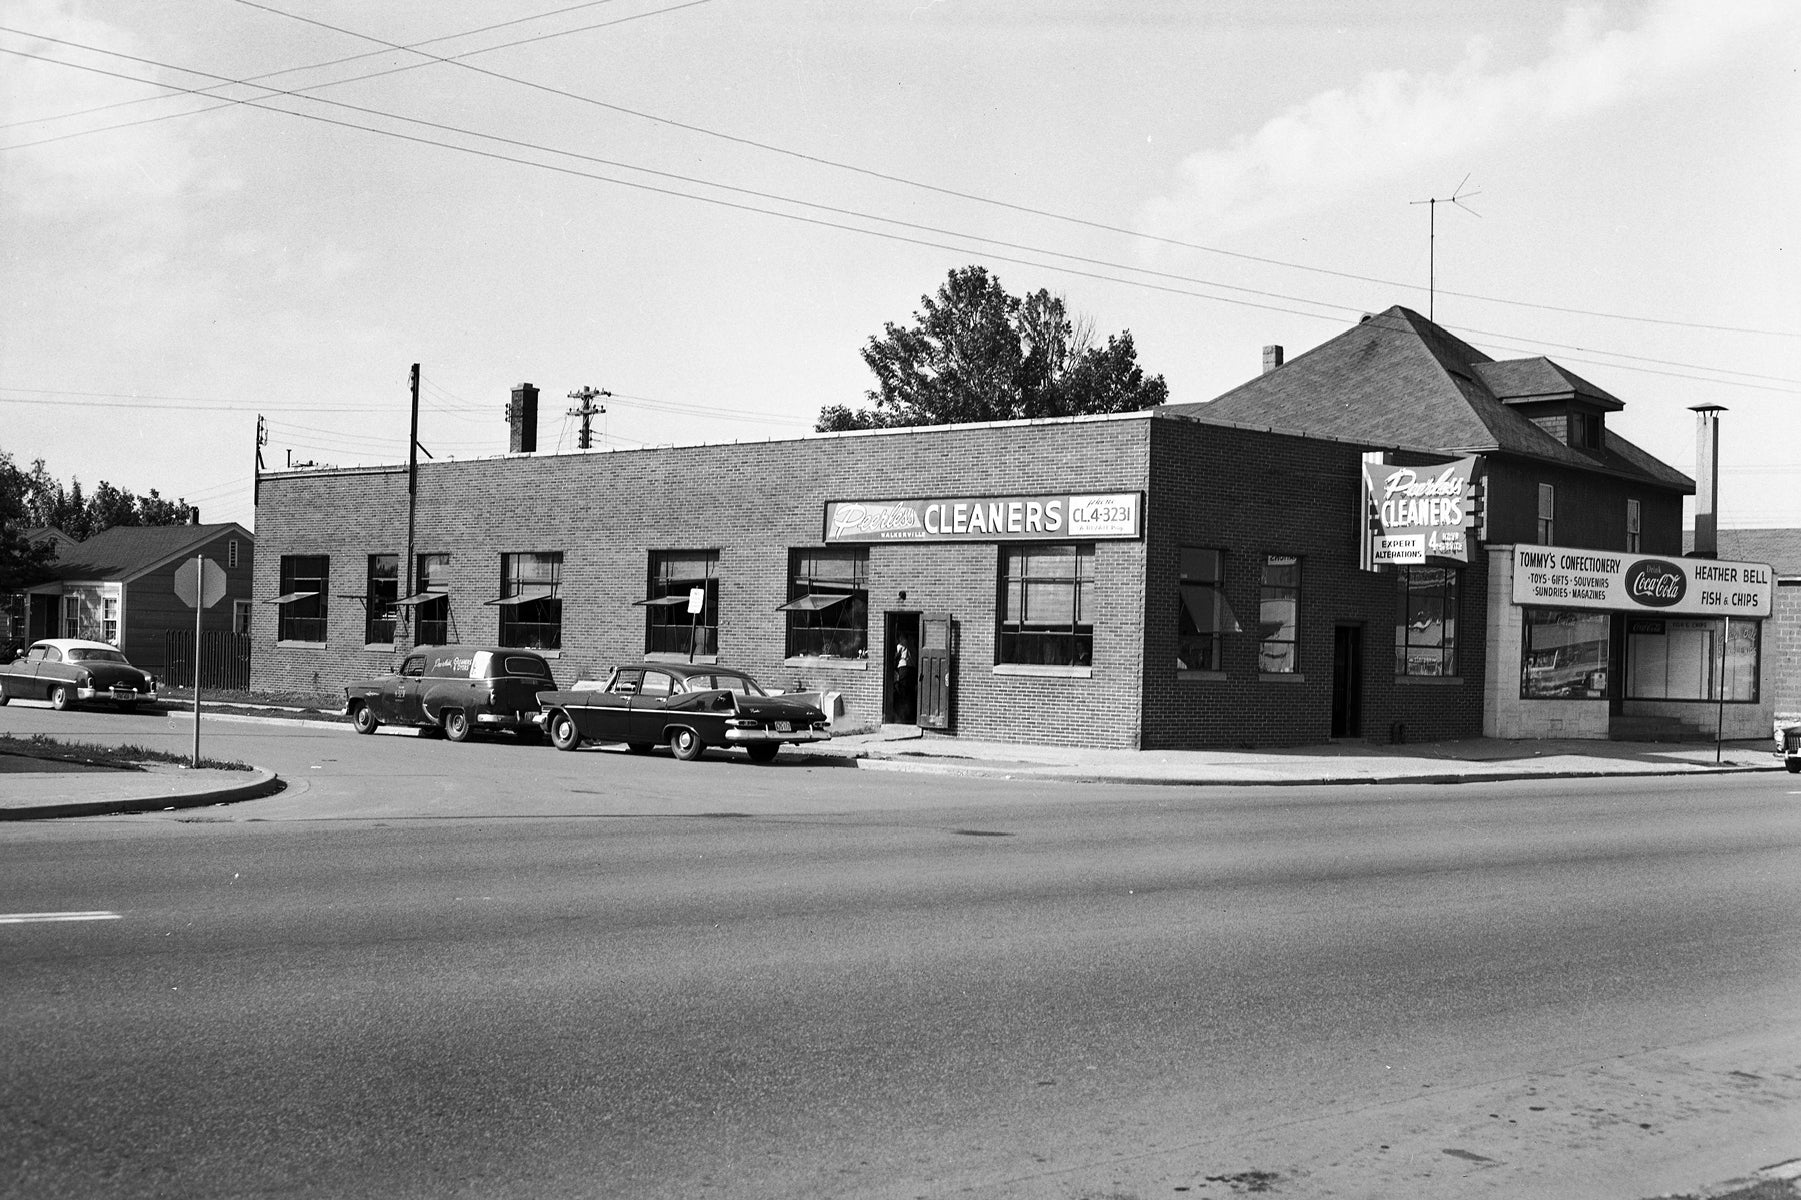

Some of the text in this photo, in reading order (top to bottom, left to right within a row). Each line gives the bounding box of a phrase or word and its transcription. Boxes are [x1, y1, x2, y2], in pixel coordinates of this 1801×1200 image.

[1384, 467, 1464, 500] Peerless
[834, 501, 915, 540] Peerless
[923, 500, 1062, 534] CLEANERS
[1381, 498, 1463, 528] CLEANERS
[1381, 540, 1417, 548] EXPERT
[1428, 530, 1438, 551] 4
[1375, 550, 1422, 559] ALTERATIONS
[1520, 552, 1621, 574] TOMMY'S CONFECTIONERY
[1530, 572, 1609, 589] TOYS GIFTS SOUVENIRS
[1633, 571, 1681, 599] Coca-Cola
[1695, 565, 1768, 584] HEATHER BELL
[1535, 586, 1606, 600] SUNDRIES MAGAZINES
[1701, 591, 1759, 607] FISH & CHIPS
